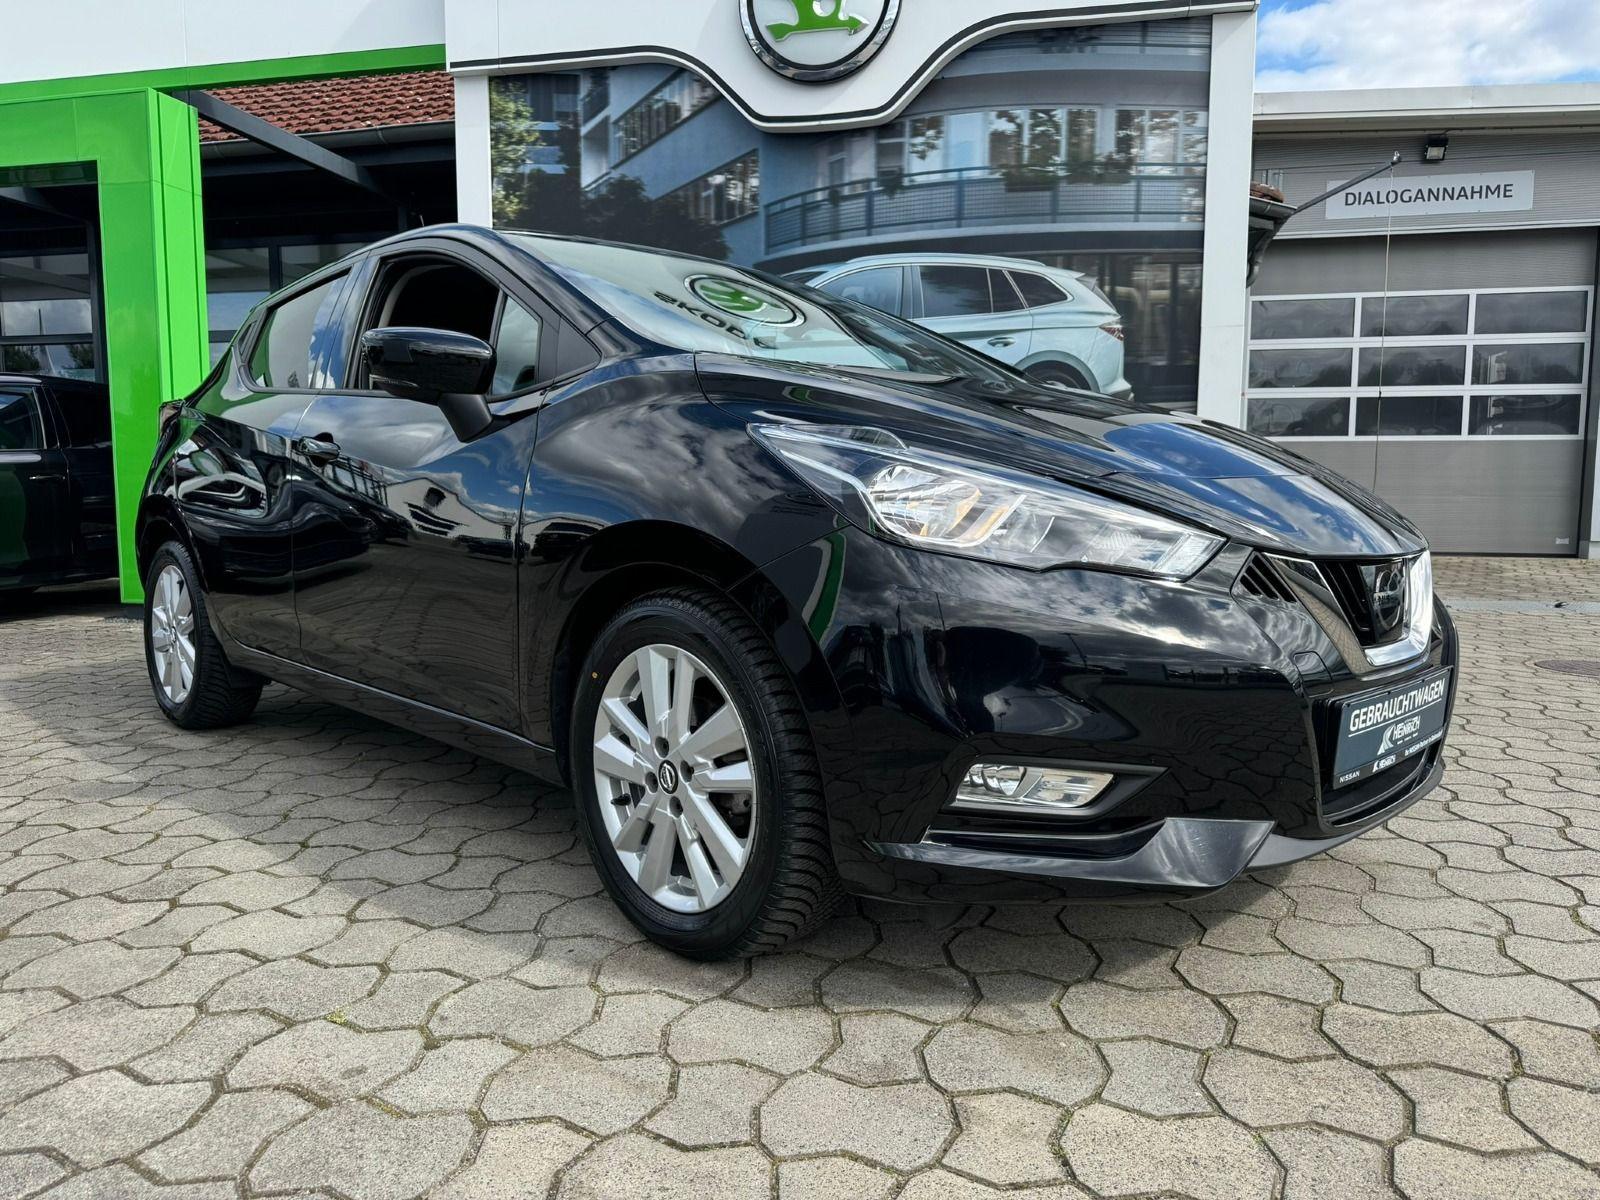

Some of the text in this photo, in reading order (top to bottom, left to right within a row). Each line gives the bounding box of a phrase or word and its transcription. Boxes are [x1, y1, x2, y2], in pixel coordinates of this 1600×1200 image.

[1344, 184, 1514, 207] DIALOGANNAHME
[1350, 678, 1446, 732] GEBRAUCHTWAGEN
[1339, 770, 1360, 784] NISSAN
